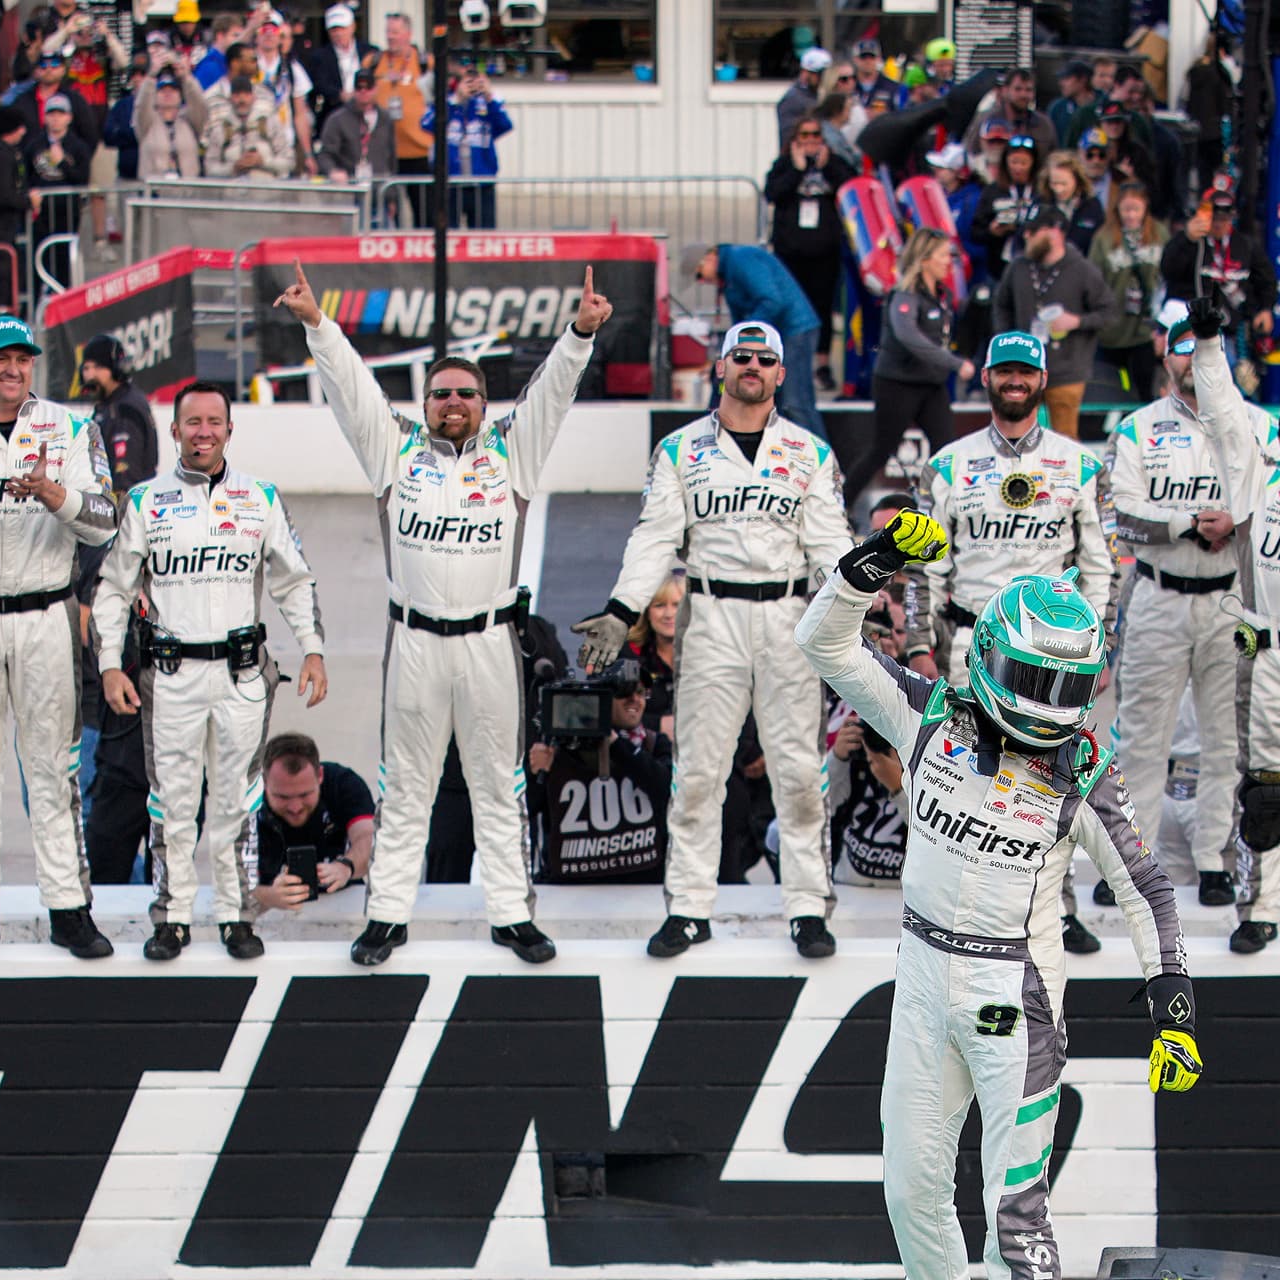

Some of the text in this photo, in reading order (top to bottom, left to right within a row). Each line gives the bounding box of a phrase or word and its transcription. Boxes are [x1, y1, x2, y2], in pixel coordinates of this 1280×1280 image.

[359, 238, 398, 258] DO
[466, 237, 556, 258] ENTER
[693, 485, 803, 519] UniFirst
[398, 508, 504, 543] UniFirst
[967, 513, 1066, 540] UniFirst
[1043, 636, 1083, 653] UniFirst
[1041, 657, 1079, 673] UniFirst
[922, 769, 956, 795] UniFirst
[923, 756, 965, 783] GOODYEAR
[995, 774, 1013, 789] NAPA
[559, 776, 654, 834] 206
[915, 788, 1041, 863] UniFirst
[581, 826, 657, 858] NASCAR
[561, 849, 658, 874] PRODUCTIONS
[945, 845, 981, 865] SERVICES
[989, 859, 1033, 875] SOLUTIONS
[929, 929, 1018, 954] ELLIOTT
[976, 1002, 1023, 1037] 9
